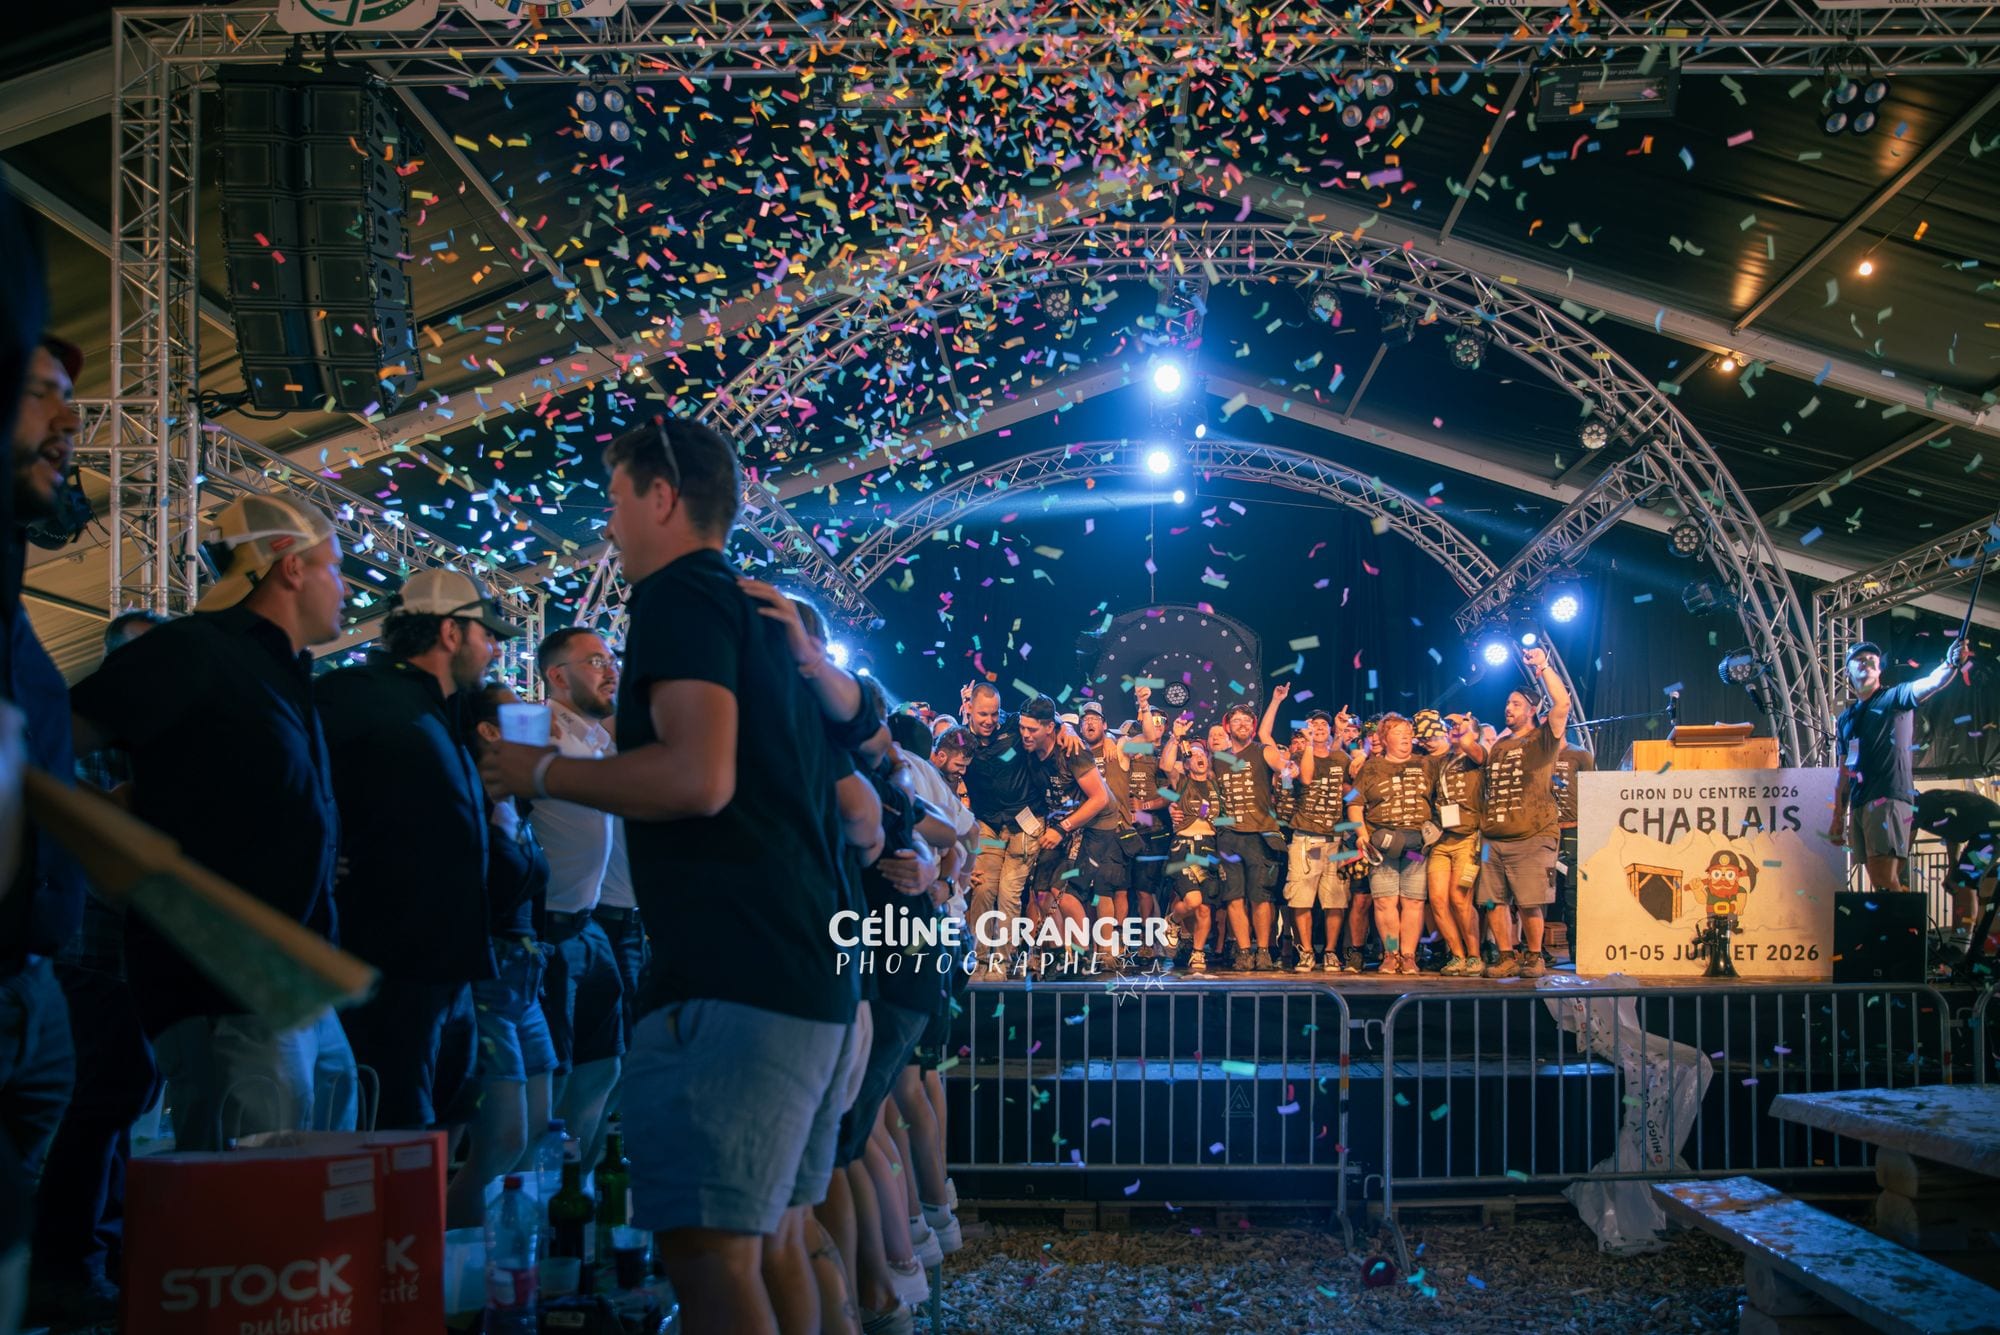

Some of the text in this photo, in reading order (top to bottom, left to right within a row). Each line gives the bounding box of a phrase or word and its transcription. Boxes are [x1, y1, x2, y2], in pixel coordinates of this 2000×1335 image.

[1620, 785, 1799, 800] GIRON DU CENTRE 2026
[1619, 805, 1802, 845] CHABLAIS
[1605, 943, 1820, 961] 01-05 JUIET 2026
[161, 1253, 353, 1312] STOCK
[240, 1295, 353, 1335] publicité
